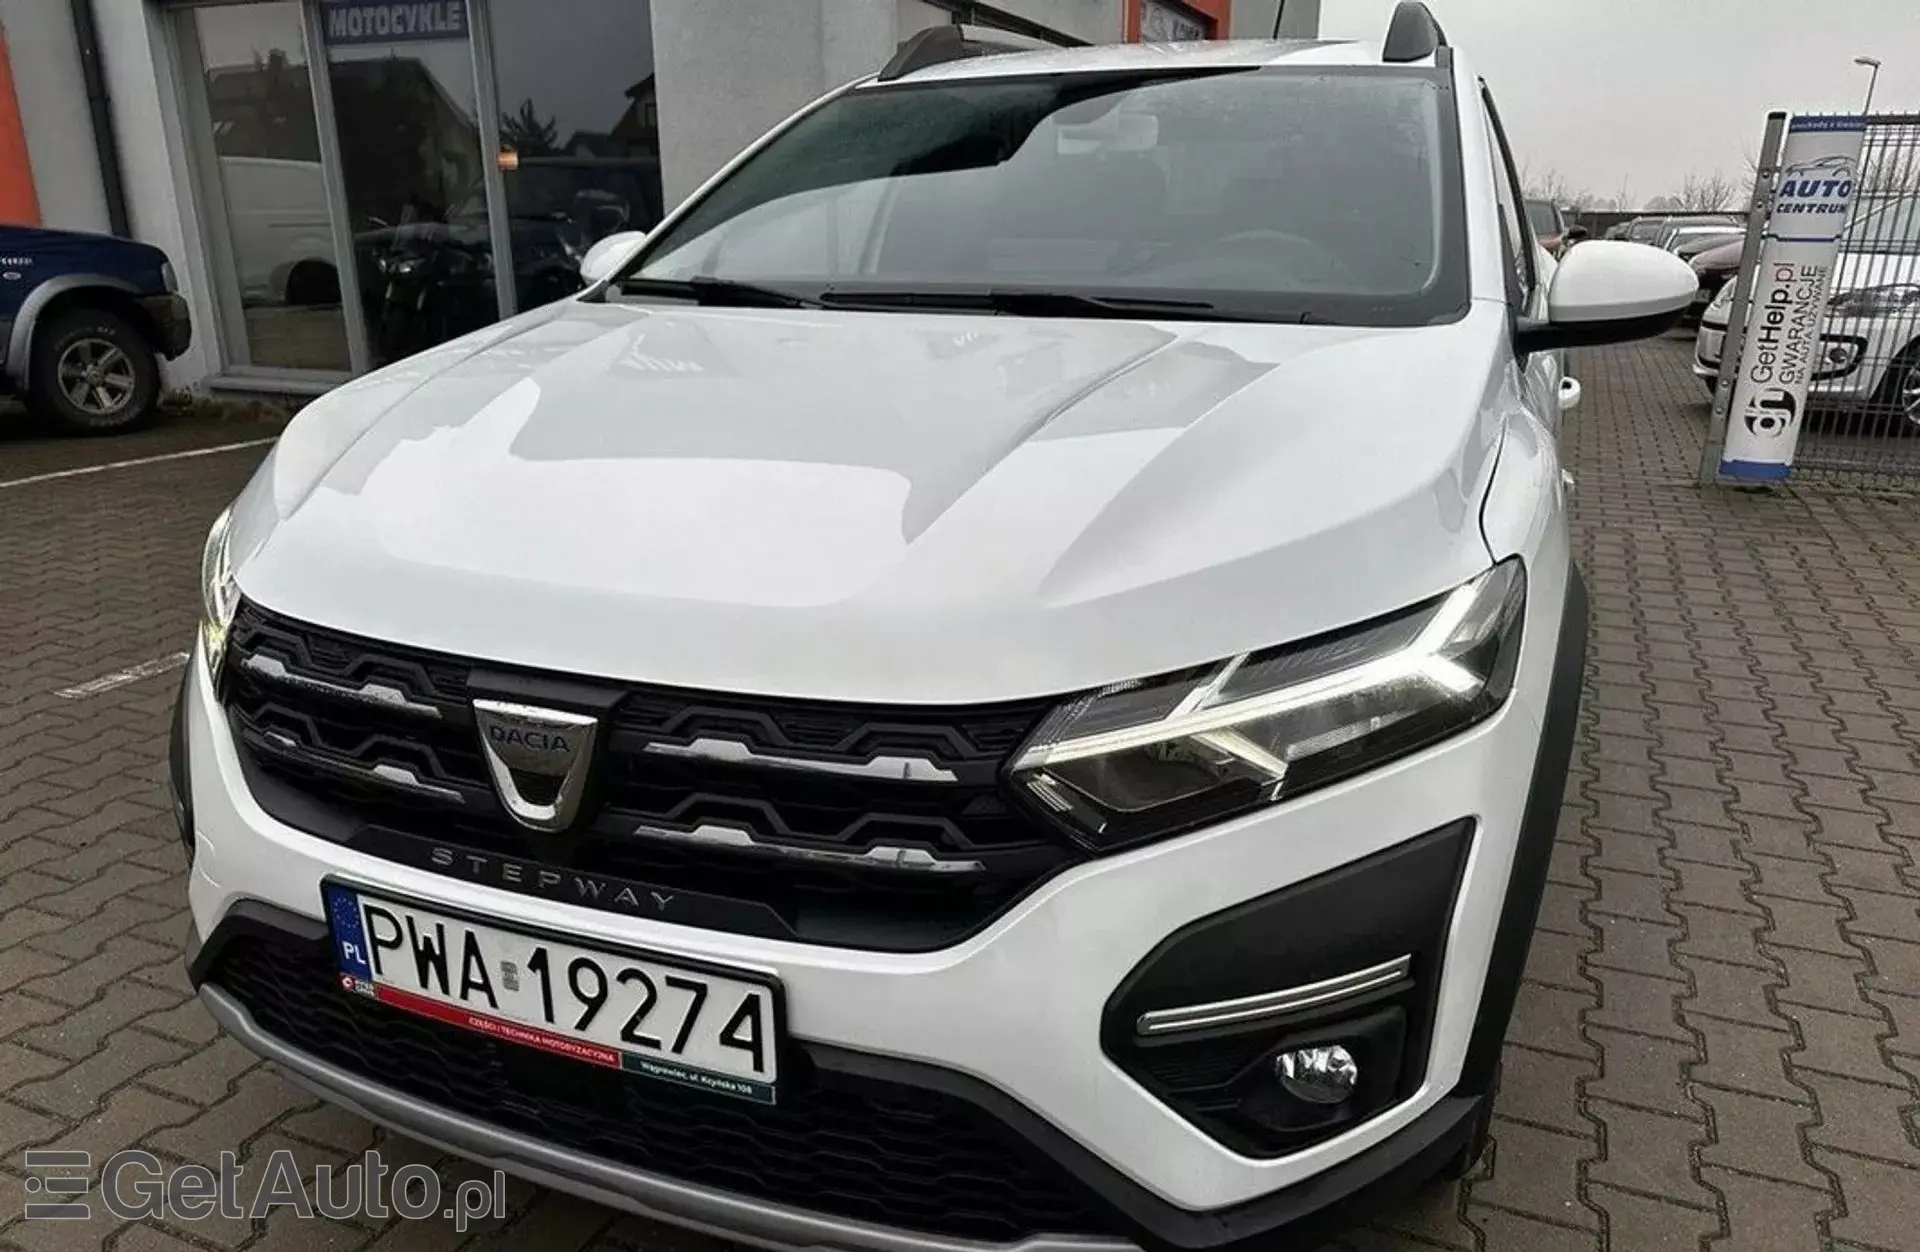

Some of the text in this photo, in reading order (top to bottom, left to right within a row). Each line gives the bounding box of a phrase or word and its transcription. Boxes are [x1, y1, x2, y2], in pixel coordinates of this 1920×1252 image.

[328, 2, 461, 36] MOTOCYKLE
[1779, 180, 1853, 197] AUTO
[1751, 262, 1796, 384] GetHelp.pl
[1779, 264, 1818, 384] GWARANCJE
[489, 725, 571, 752] DACIA
[431, 847, 674, 911] STEPWAY
[342, 941, 367, 965] PL
[361, 903, 764, 1073] PWA 19274
